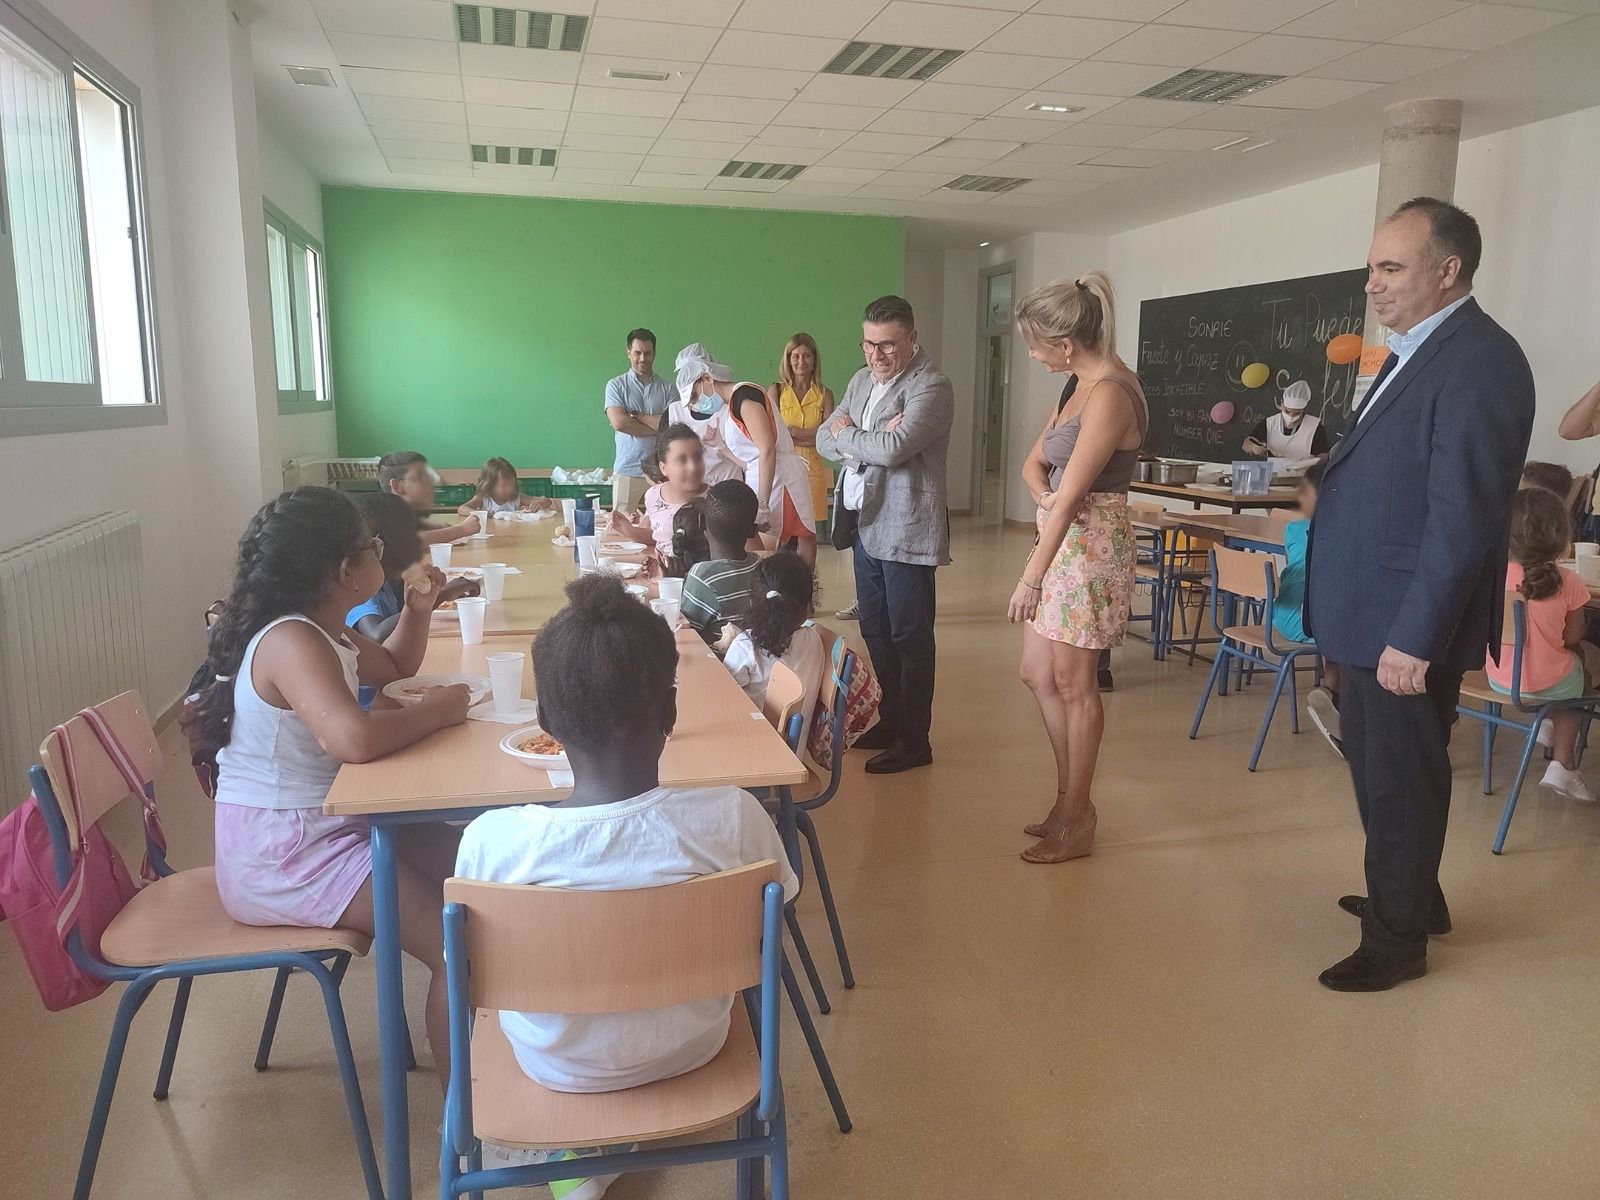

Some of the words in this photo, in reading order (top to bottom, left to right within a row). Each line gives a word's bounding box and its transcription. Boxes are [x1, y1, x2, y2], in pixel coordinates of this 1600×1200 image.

[1187, 315, 1233, 339] SONRIE
[1174, 347, 1183, 376] y
[1172, 422, 1204, 441] NUMBER
[1206, 425, 1225, 447] ONE
